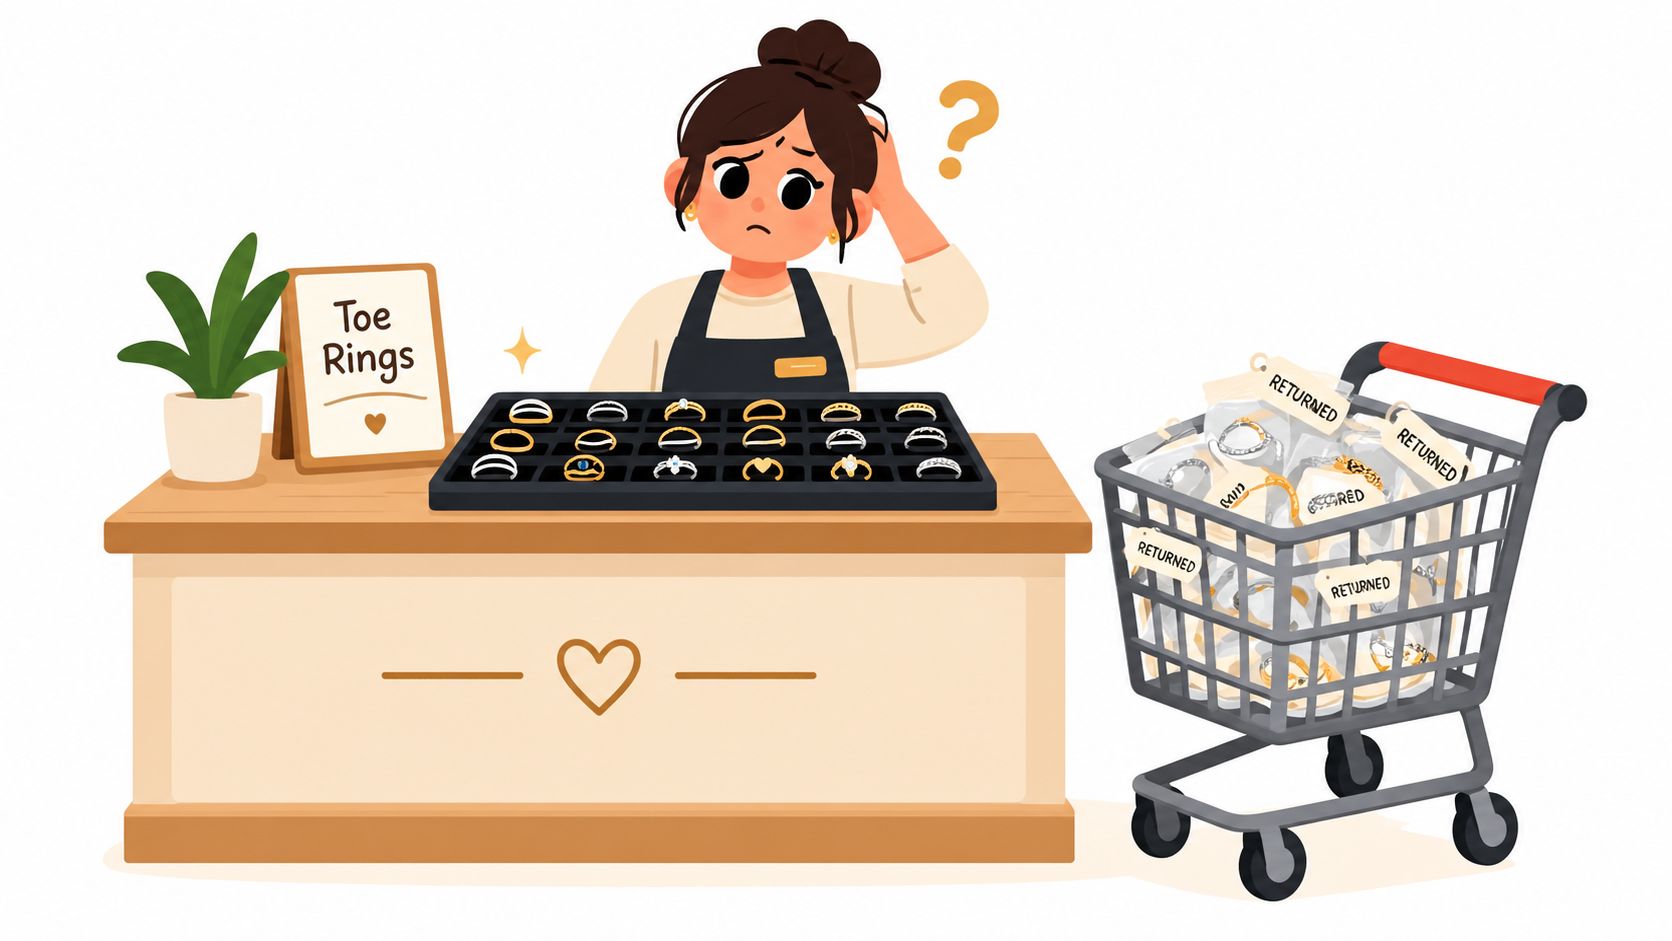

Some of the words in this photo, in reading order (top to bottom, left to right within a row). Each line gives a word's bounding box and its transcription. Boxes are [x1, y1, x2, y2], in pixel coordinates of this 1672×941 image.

[333, 299, 391, 333] Toe
[323, 343, 415, 384] Rings
[1269, 374, 1338, 422] RETURNED
[1396, 428, 1457, 482] RETURNED
[1138, 541, 1196, 573] RETURNED
[1331, 576, 1390, 599] RETURNED
